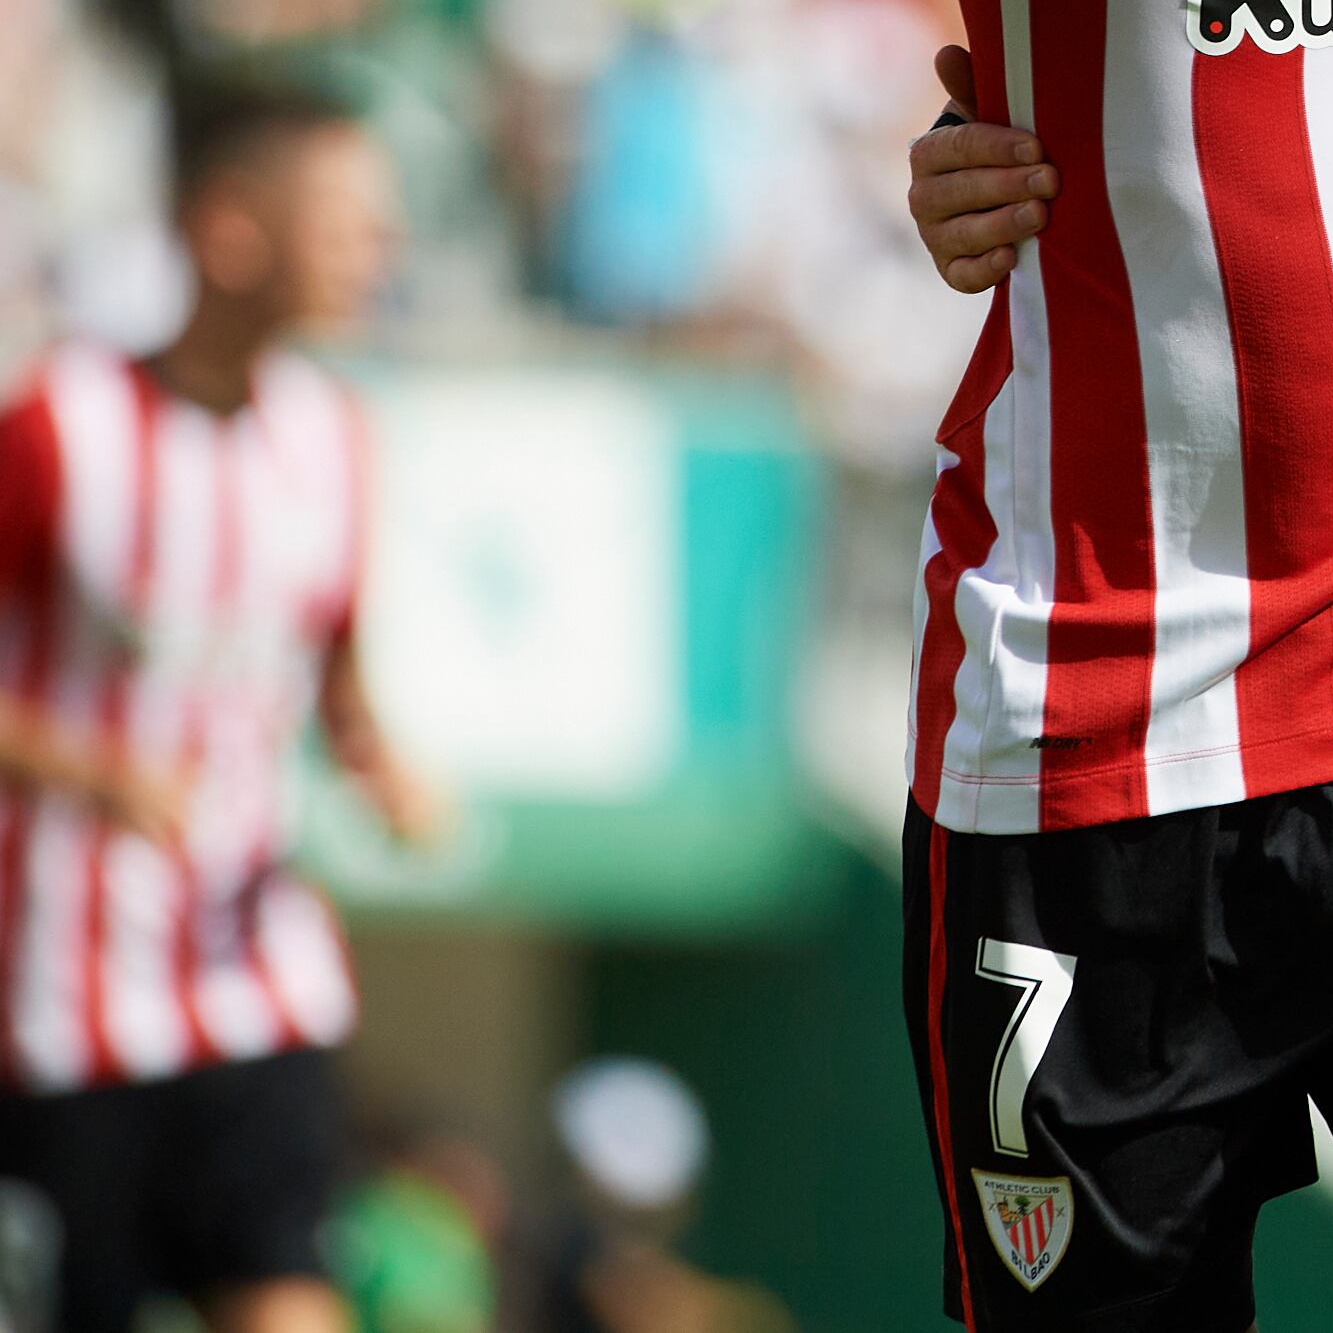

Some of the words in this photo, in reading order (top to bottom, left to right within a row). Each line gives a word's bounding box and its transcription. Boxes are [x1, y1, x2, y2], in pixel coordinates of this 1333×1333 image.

[975, 936, 1078, 1158] 7
[985, 1181, 1030, 1193] ATHLETIC
[1031, 1186, 1060, 1194] CLUB
[1011, 1250, 1050, 1280] BILBAO
